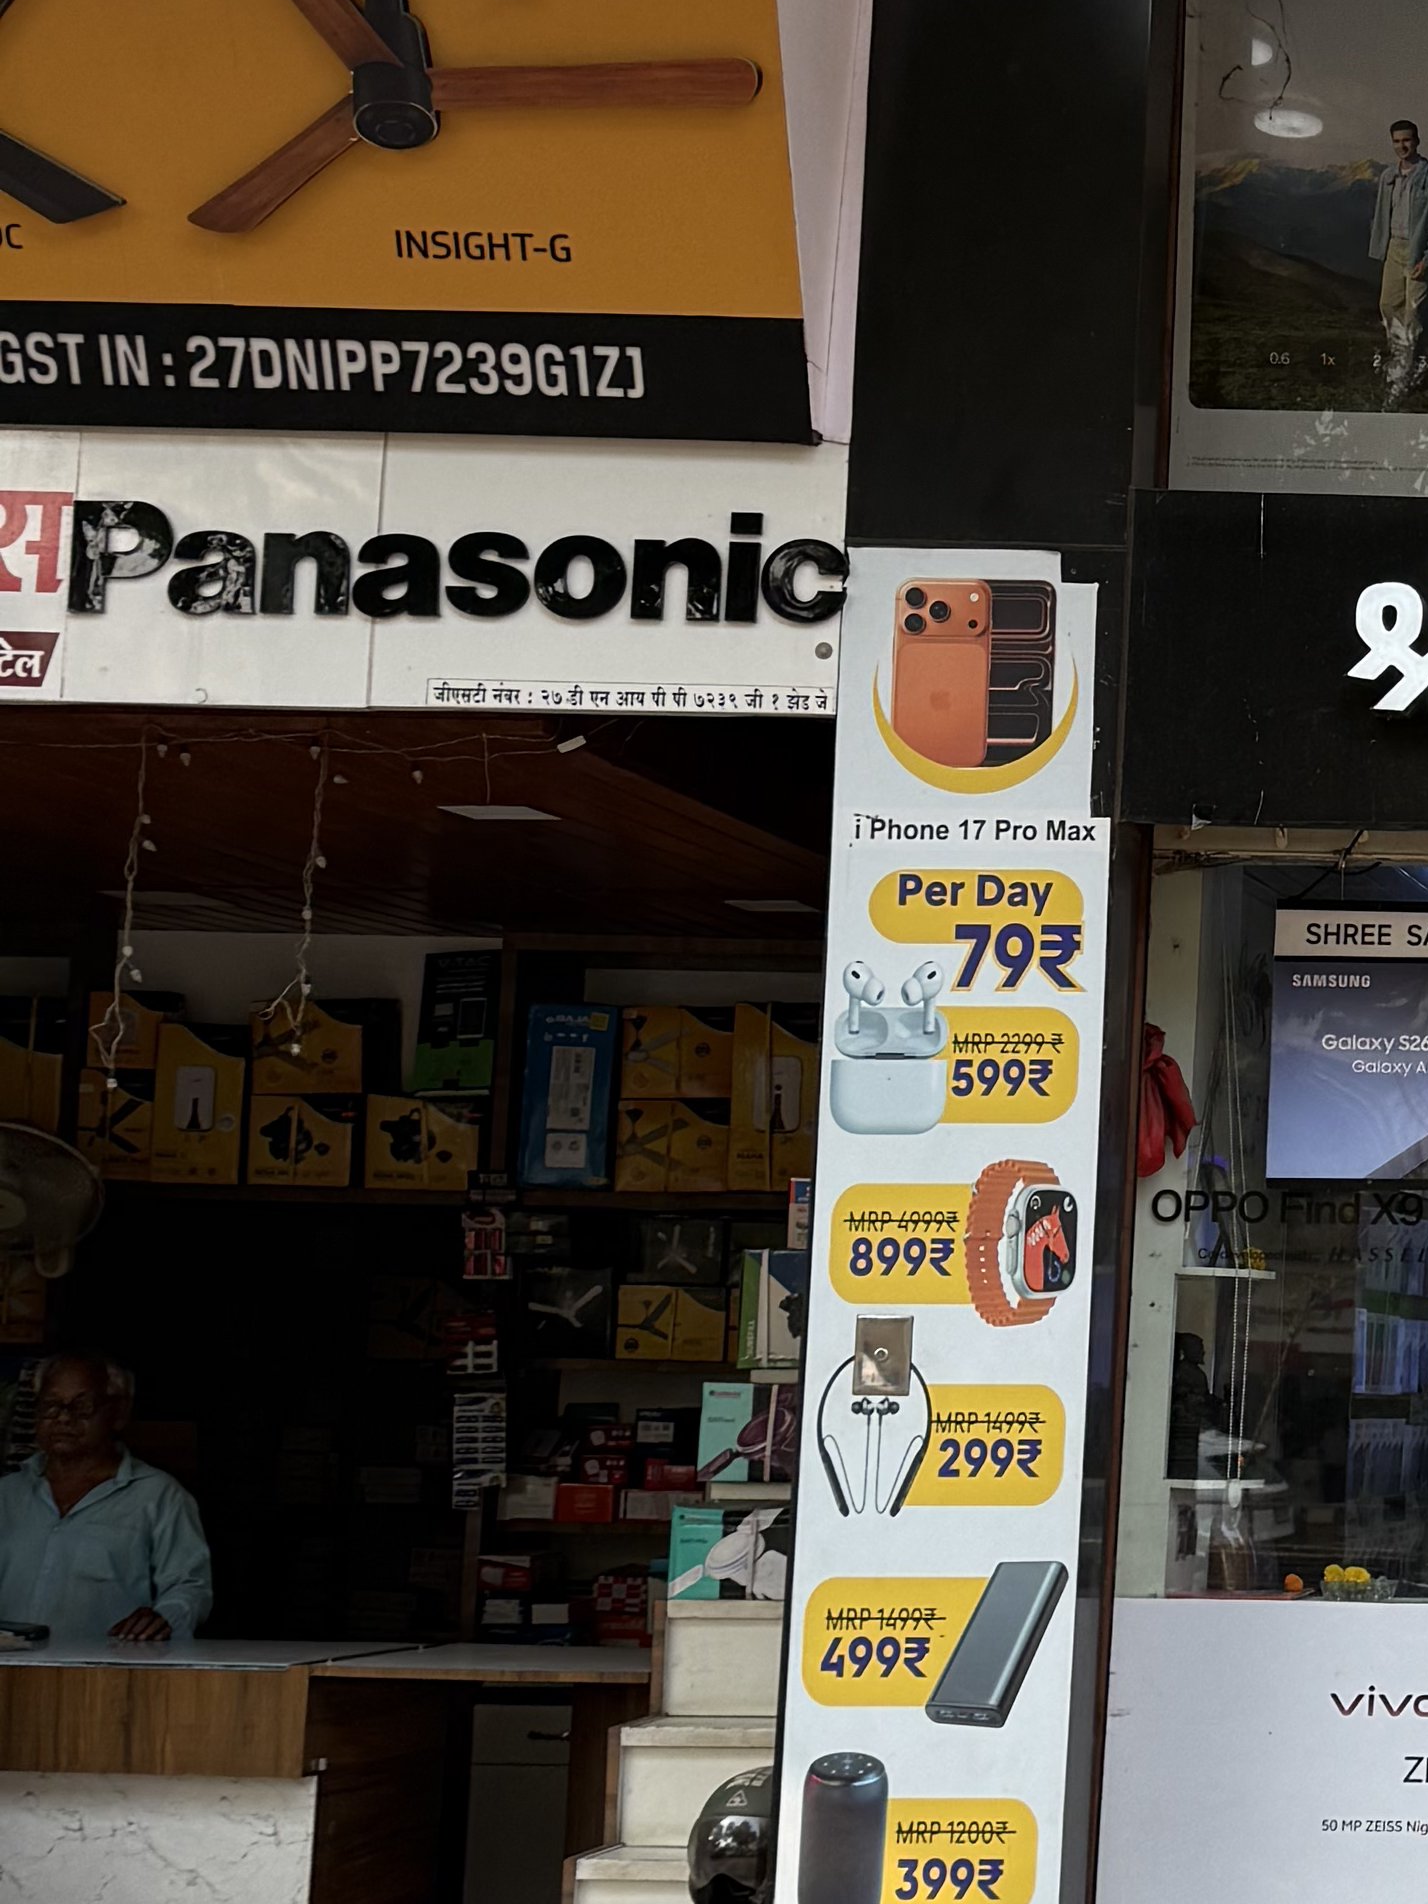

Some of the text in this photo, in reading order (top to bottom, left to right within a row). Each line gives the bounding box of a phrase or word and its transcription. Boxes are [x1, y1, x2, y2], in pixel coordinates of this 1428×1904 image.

[395, 229, 572, 263] INSIGHT-G
[0, 331, 85, 385] GST
[98, 334, 149, 387] IN
[68, 499, 849, 624] Panasonic
[433, 682, 487, 704] जीएसटी
[1306, 923, 1392, 946] SHREE
[952, 922, 1087, 992] 79₹
[1292, 973, 1370, 989] SAMSUNG
[1321, 1033, 1396, 1055] Galaxy
[1352, 1059, 1412, 1077] Galaxy
[1150, 1189, 1269, 1226] OPPO
[1280, 1191, 1360, 1225] Find
[1371, 1192, 1421, 1226] X9
[1321, 1819, 1338, 1832] 50
[1341, 1820, 1362, 1832] MP
[1365, 1821, 1402, 1833] ZEISS
